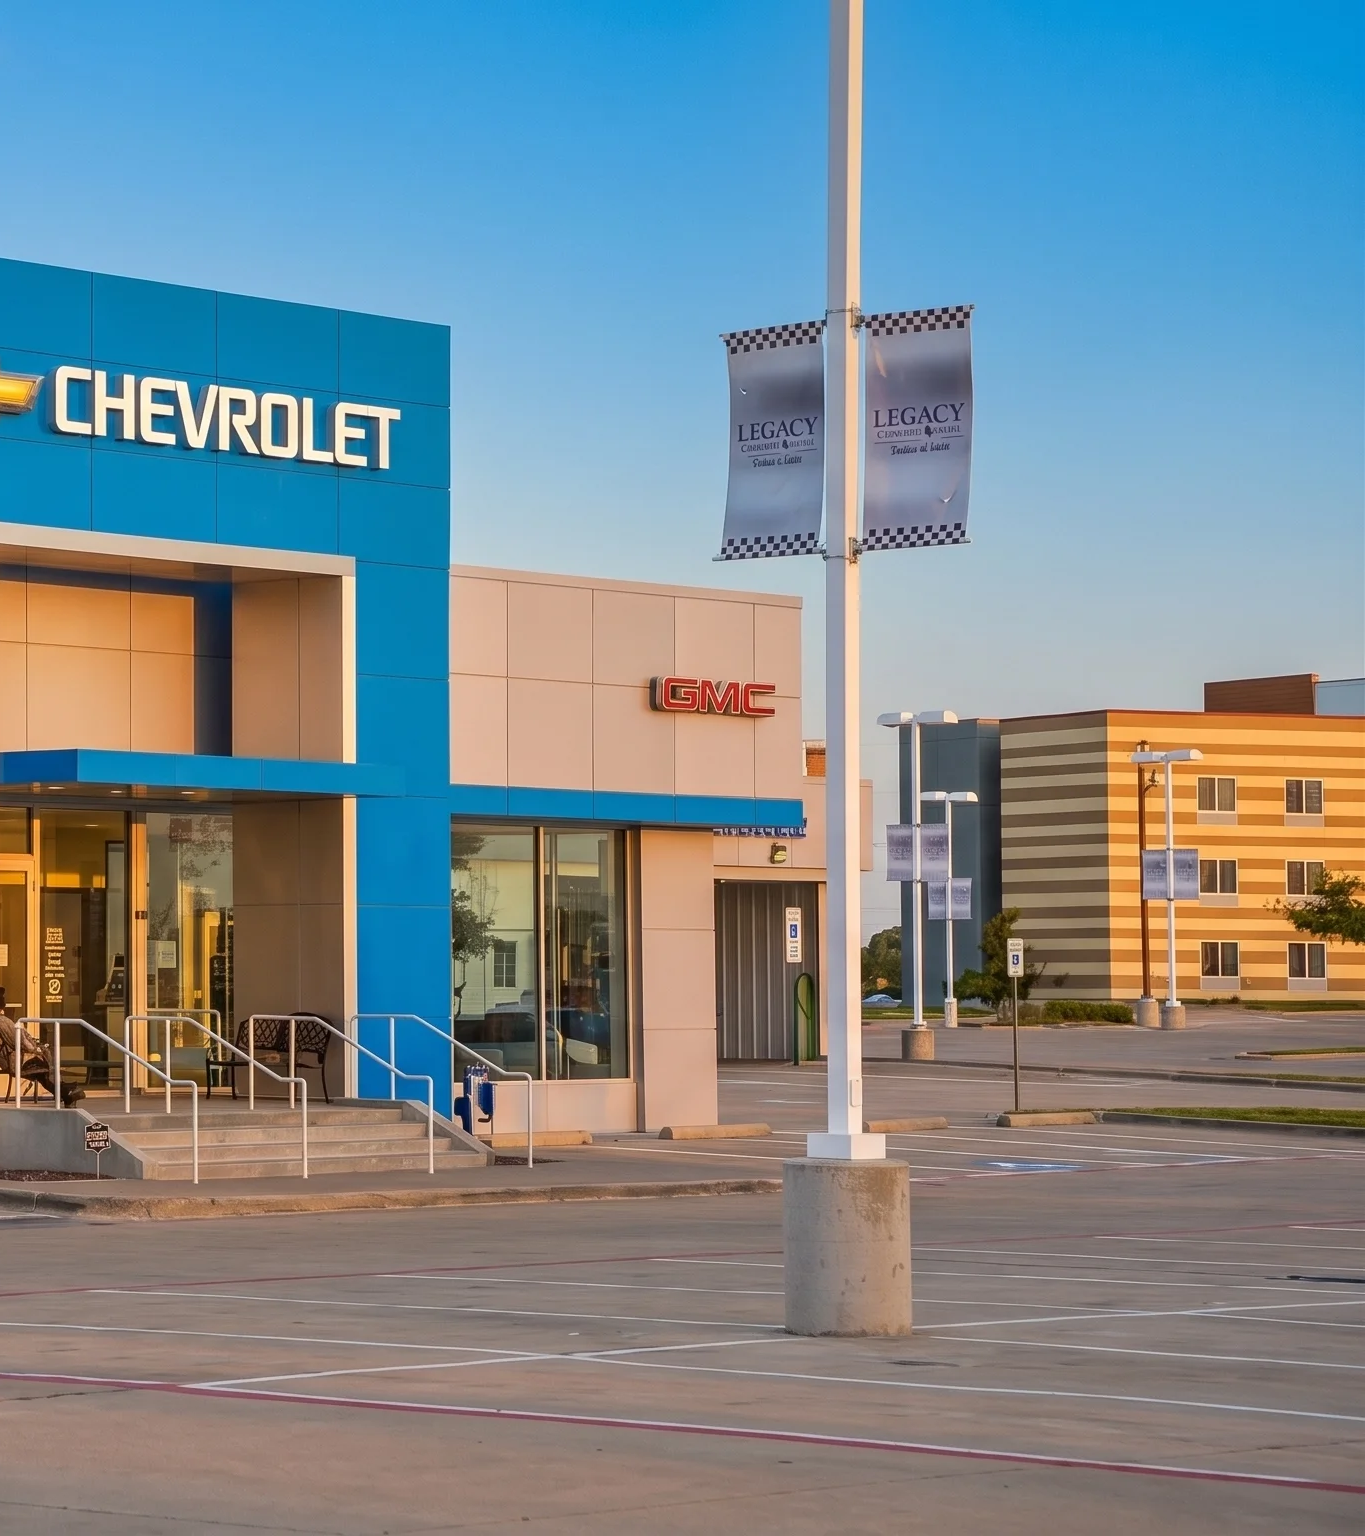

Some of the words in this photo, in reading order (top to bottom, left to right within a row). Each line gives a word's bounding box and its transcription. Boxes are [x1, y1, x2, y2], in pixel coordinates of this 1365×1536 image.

[49, 365, 401, 470] CHEVROLET
[737, 416, 819, 442] LEGACY
[873, 402, 965, 428] LEGACY
[659, 676, 776, 718] GMC
